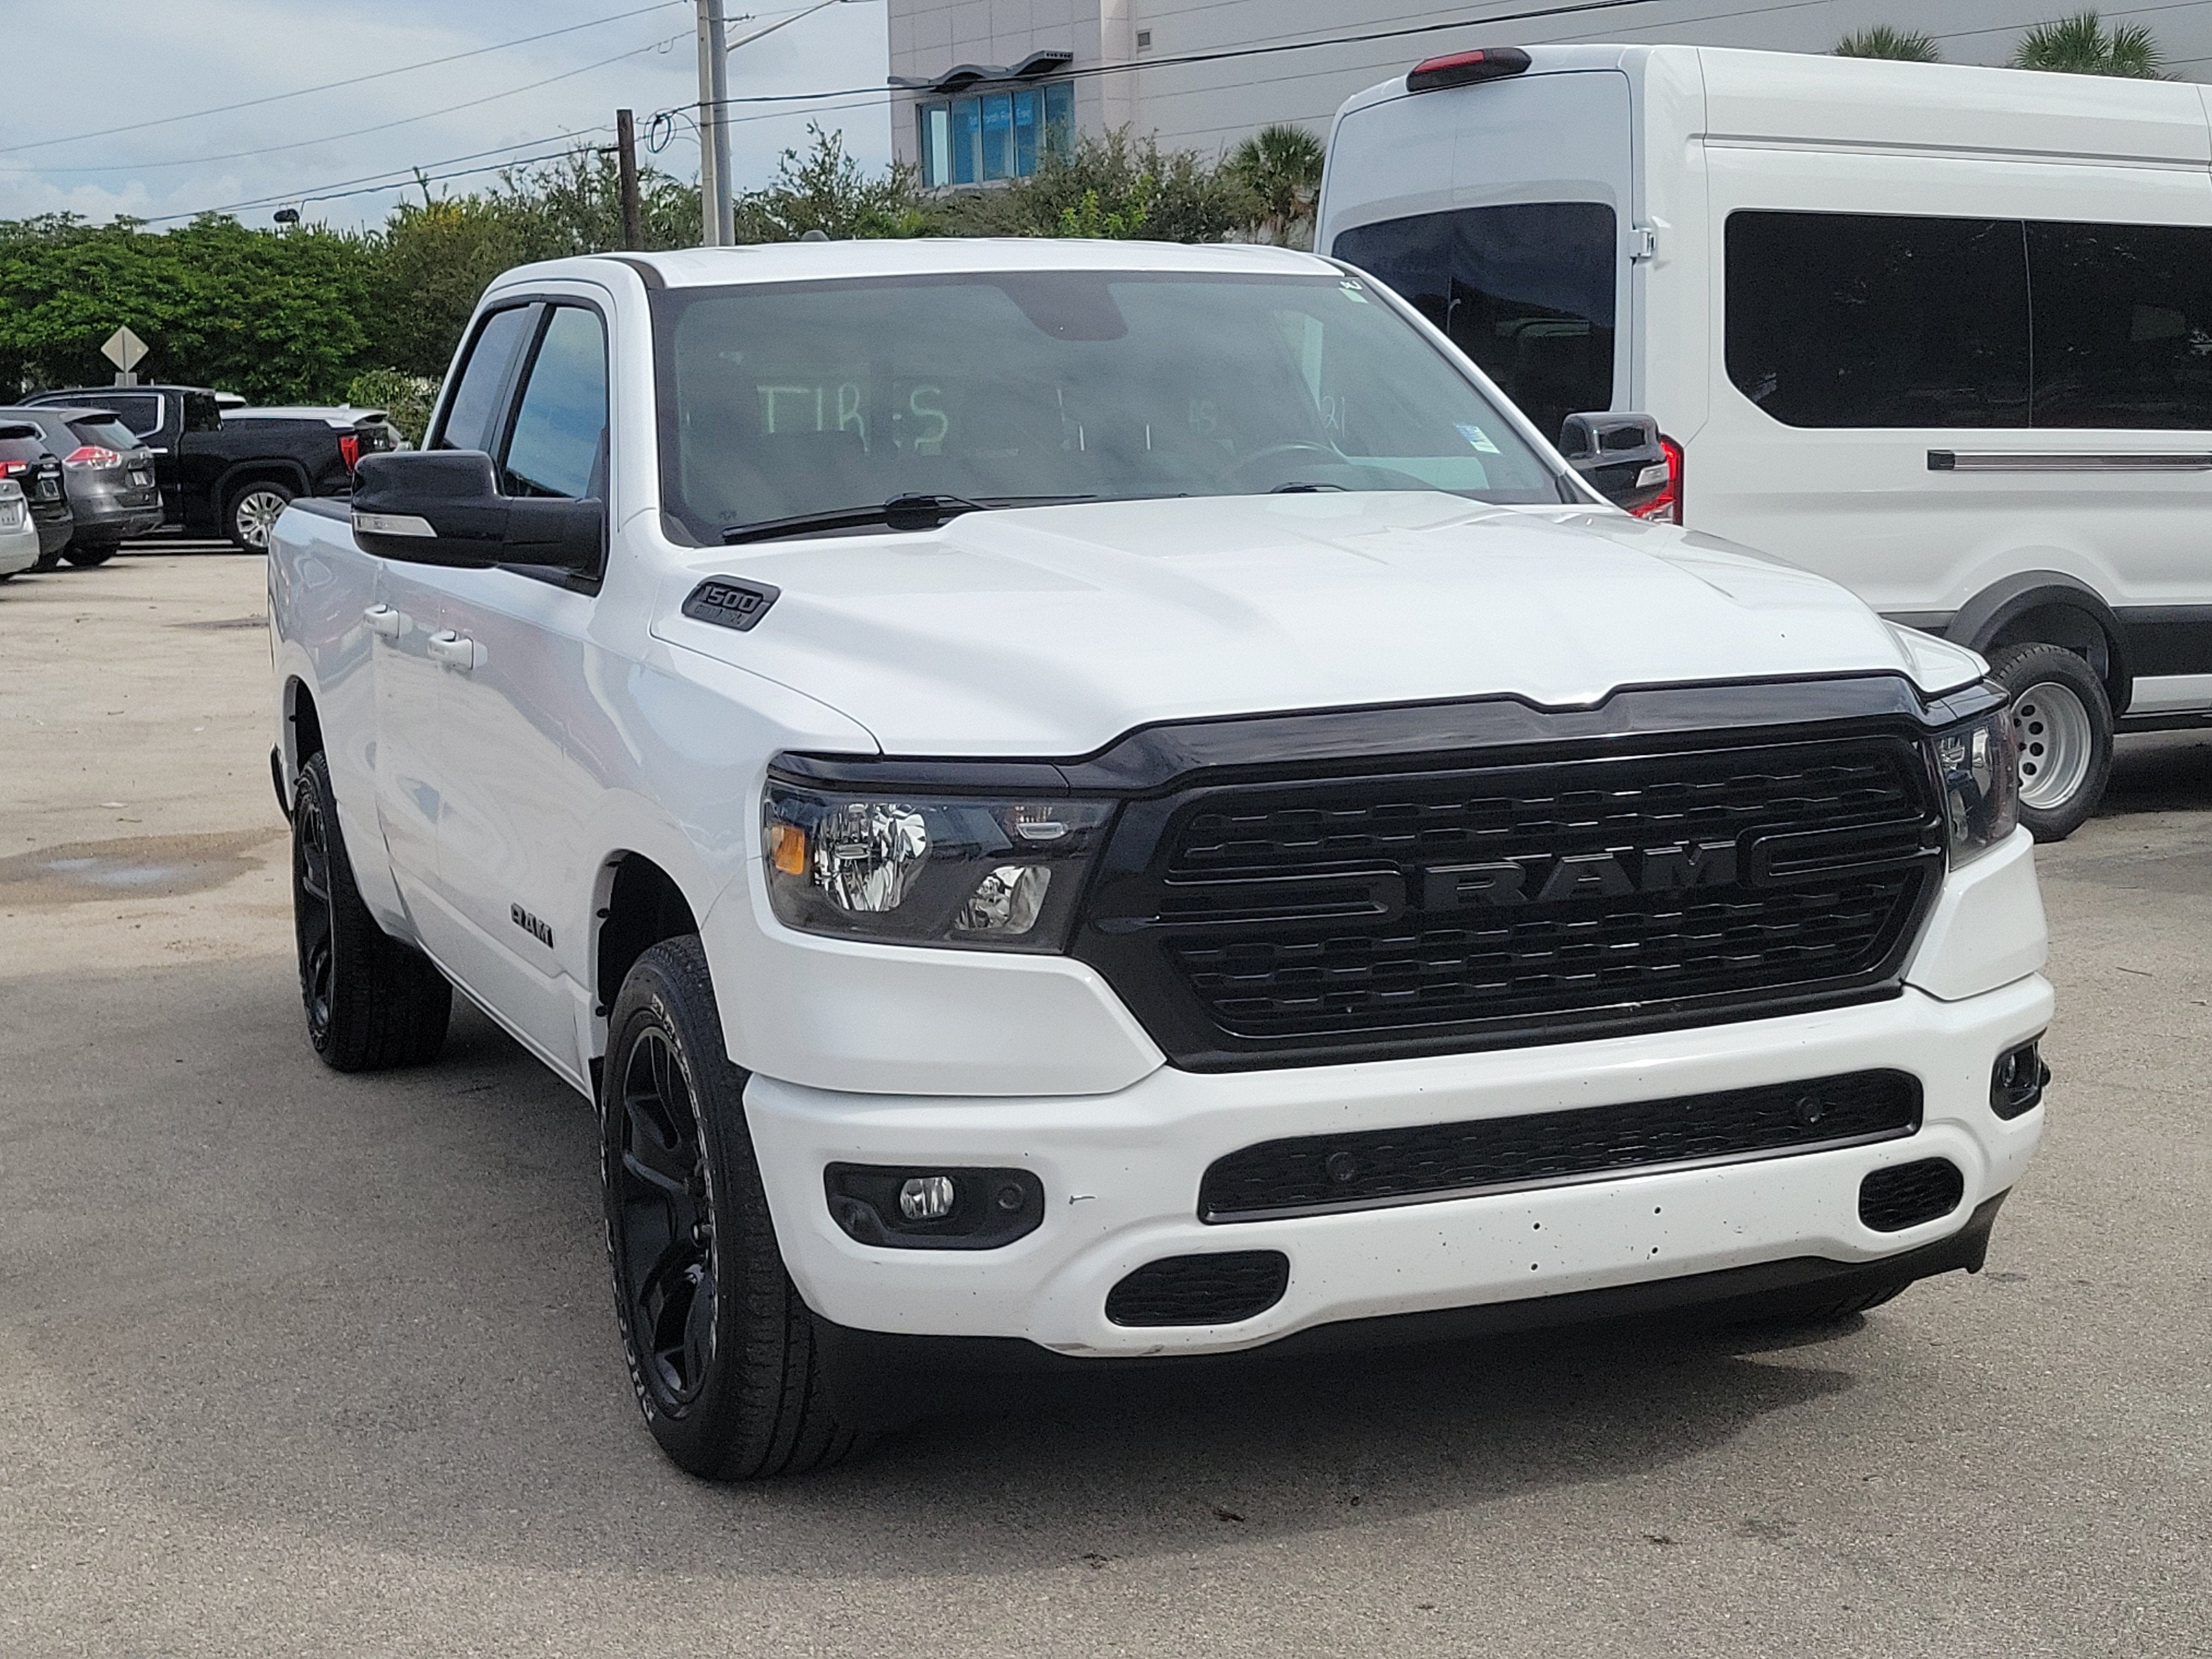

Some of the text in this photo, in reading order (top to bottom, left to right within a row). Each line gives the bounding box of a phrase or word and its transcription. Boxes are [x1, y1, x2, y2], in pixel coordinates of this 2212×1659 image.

[756, 383, 948, 452] TIRS
[699, 585, 762, 611] 1500
[1424, 839, 1736, 911] RAM
[510, 902, 554, 950] RAM
